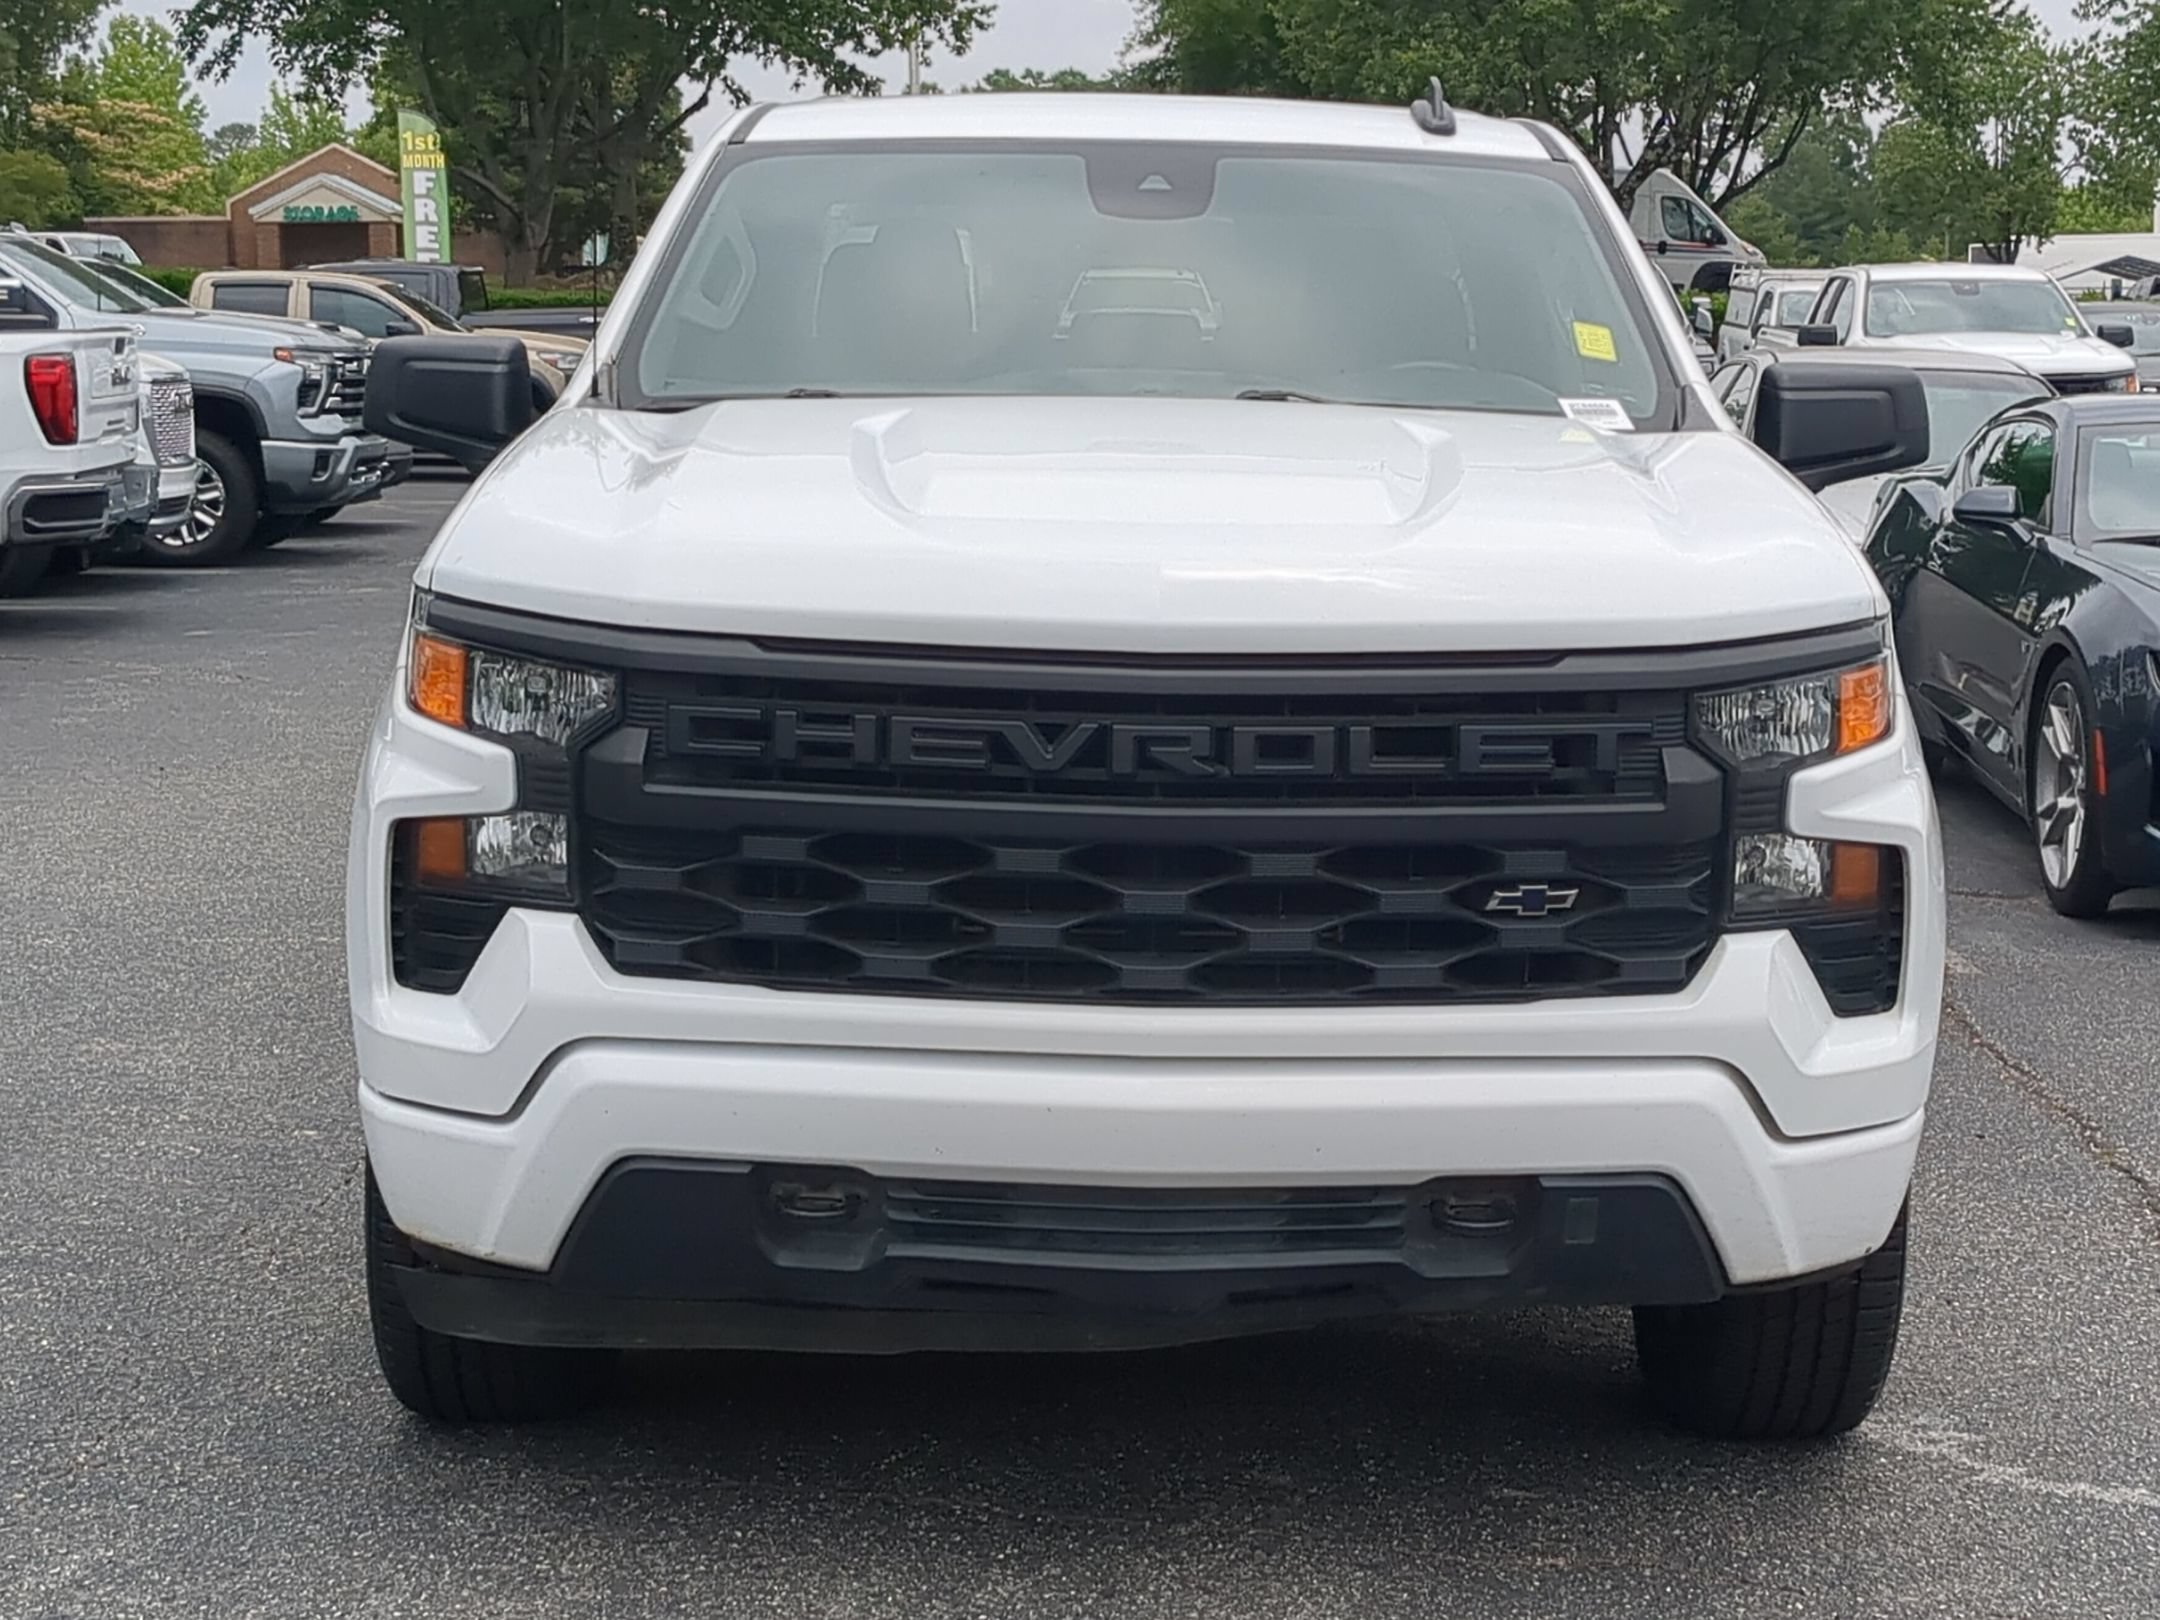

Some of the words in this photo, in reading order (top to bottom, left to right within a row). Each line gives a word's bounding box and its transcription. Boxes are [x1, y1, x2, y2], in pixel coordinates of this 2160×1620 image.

[402, 131, 435, 150] 1st
[402, 153, 445, 169] MONTH
[283, 205, 359, 221] STORAGE
[667, 704, 1652, 776] CHEVROLET
